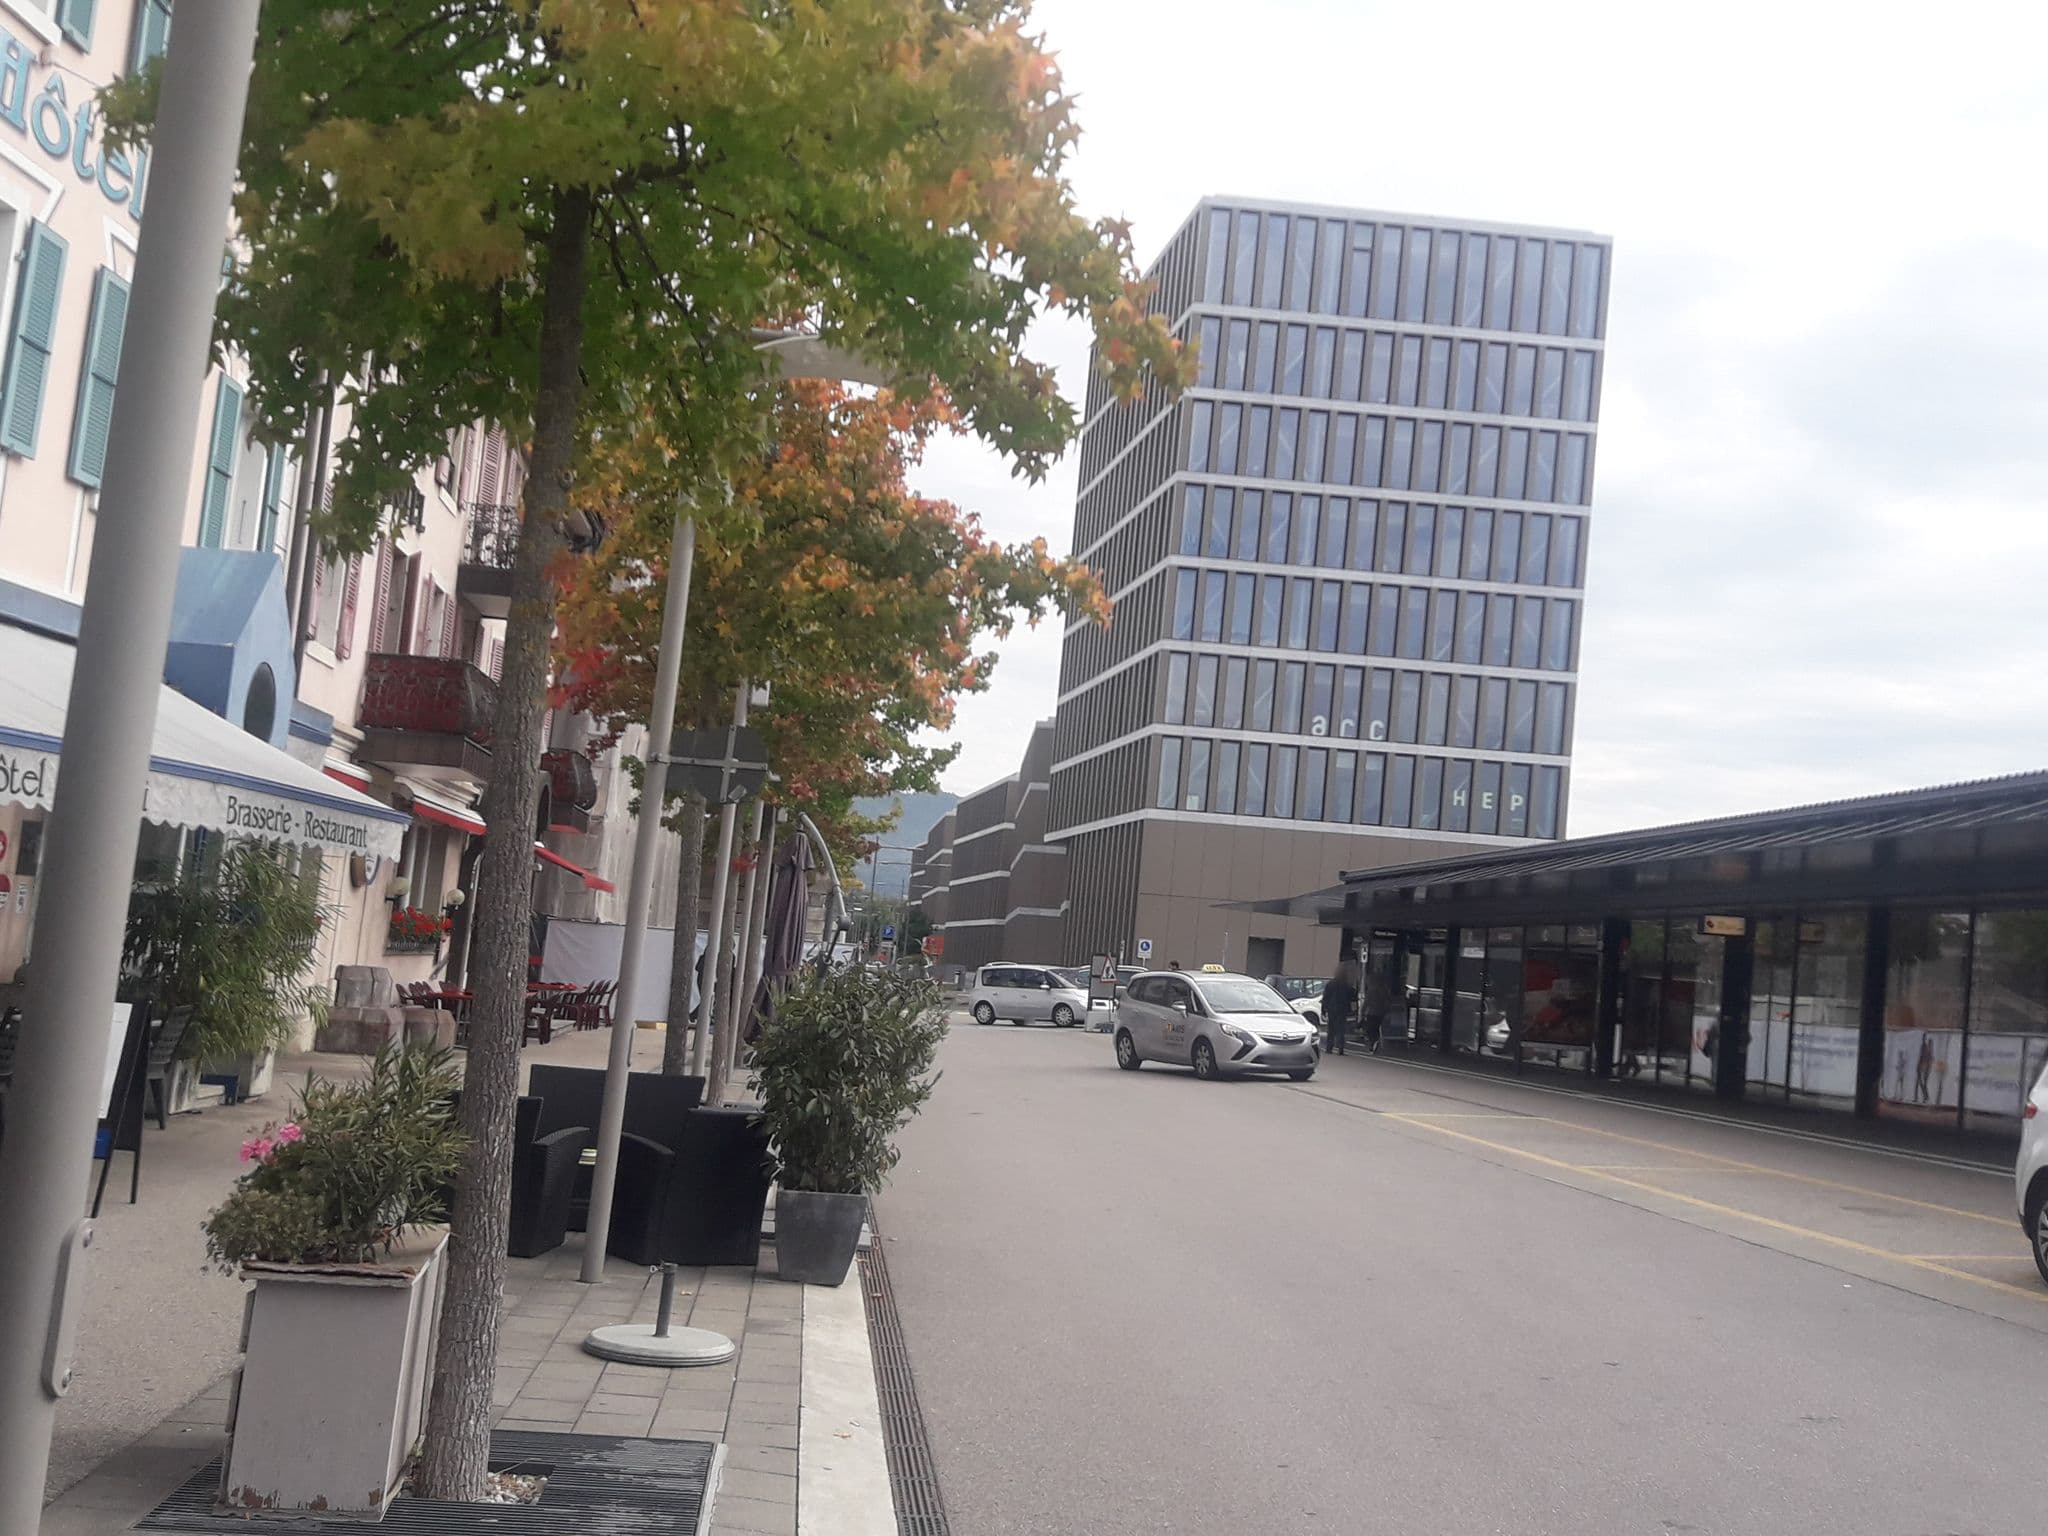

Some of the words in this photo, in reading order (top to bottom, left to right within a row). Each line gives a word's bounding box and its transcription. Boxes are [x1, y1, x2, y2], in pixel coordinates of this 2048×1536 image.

[1311, 714, 1385, 741] arc
[226, 796, 292, 834] Brasserie
[303, 810, 368, 847] Restaurant
